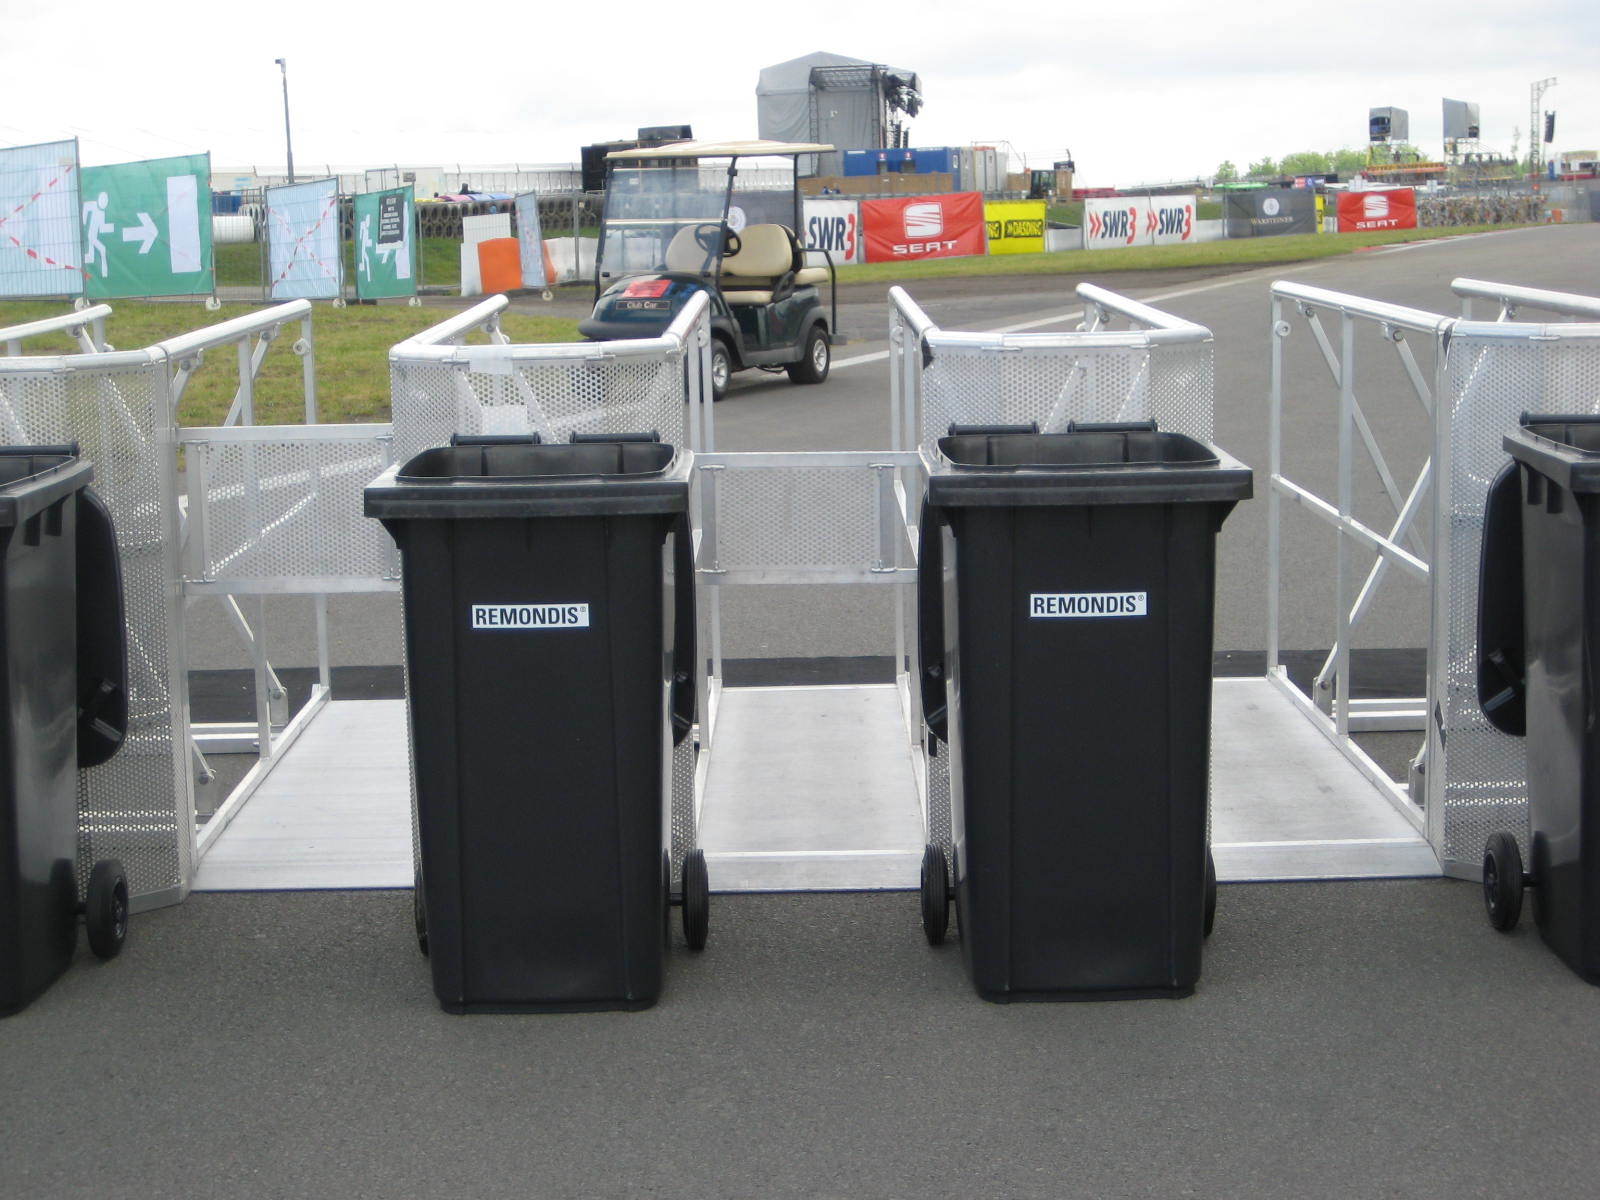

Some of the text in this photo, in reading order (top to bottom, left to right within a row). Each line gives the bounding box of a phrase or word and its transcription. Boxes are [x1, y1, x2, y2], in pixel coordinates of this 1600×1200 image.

[1100, 206, 1137, 245] SWR3
[1158, 204, 1192, 241] SWR3
[1355, 219, 1399, 230] SEAT
[807, 213, 857, 261] SWR3
[892, 240, 958, 255] SEAT
[643, 300, 657, 309] Car
